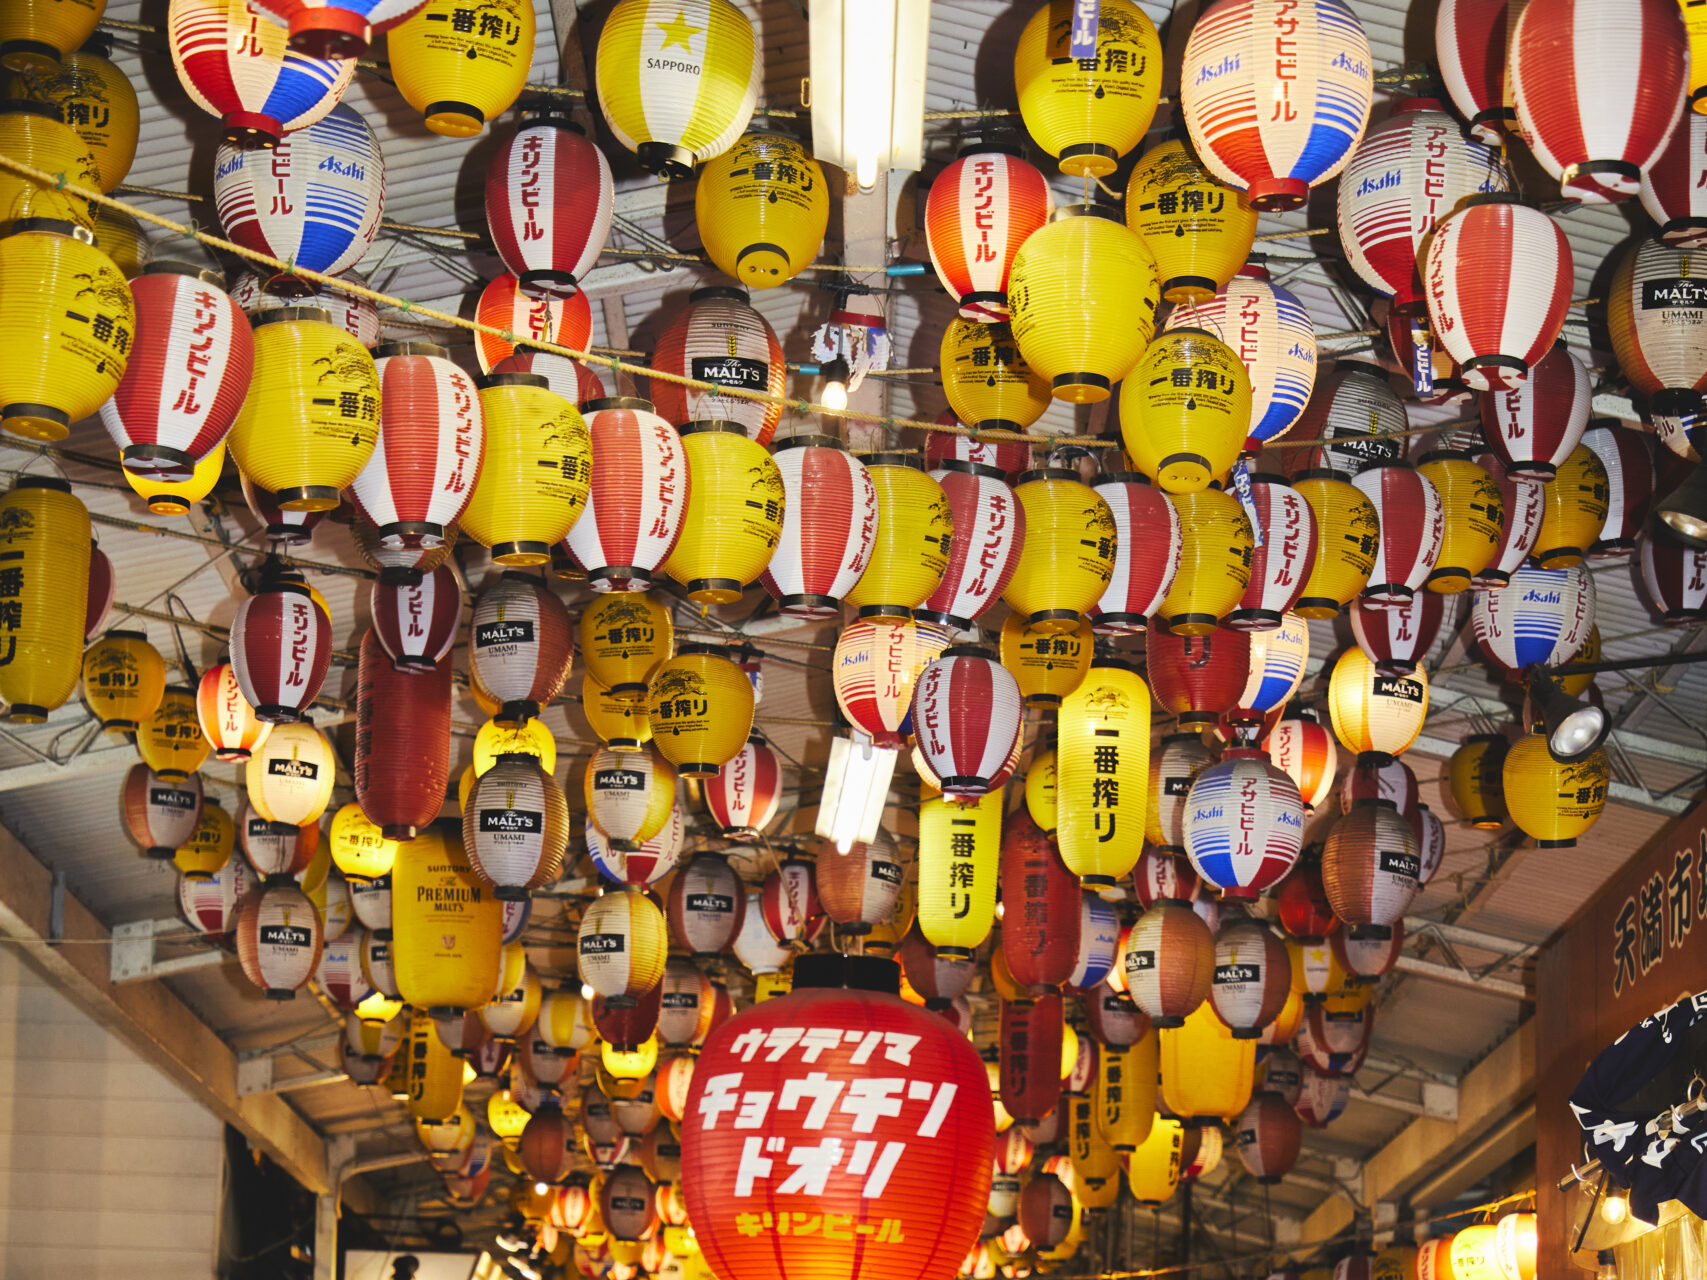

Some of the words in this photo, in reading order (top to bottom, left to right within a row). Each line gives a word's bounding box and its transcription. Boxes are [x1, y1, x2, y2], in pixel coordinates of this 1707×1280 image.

[426, 9, 520, 46] 一番搾り
[647, 58, 701, 75] SAPPORO
[1051, 49, 1146, 76] 一番搾り
[1196, 53, 1241, 87] Asahi
[1270, 0, 1300, 122] アサヒビール
[1331, 51, 1368, 81] Asahi
[64, 102, 109, 128] 搾り
[319, 155, 364, 181] Asahi
[730, 162, 814, 192] 一番搾り
[1417, 126, 1448, 234] アサヒビール
[522, 135, 544, 241] キリンビール
[1357, 169, 1401, 198] Asahi
[974, 161, 997, 263] キリンビール
[1139, 191, 1225, 216] 一番搾り
[1430, 221, 1455, 334] キリンビール
[1661, 311, 1704, 320] UMAMI
[66, 310, 132, 356] 一番搾
[1239, 295, 1260, 394] アサヒビー
[173, 291, 218, 415] キリンビール
[723, 358, 743, 367] The
[1286, 341, 1314, 366] Asahi
[703, 365, 760, 382] MALT'S
[1149, 368, 1235, 396] 一番搾り
[312, 390, 381, 421] 一番搾
[444, 374, 469, 494] キリンビール
[538, 455, 593, 485] 一番搾
[648, 425, 676, 538] キリンビール
[1513, 481, 1541, 552] リンビール
[965, 494, 1006, 597] キリンビール
[1274, 495, 1300, 586] キリンビール
[407, 584, 424, 637] ンビール
[1523, 589, 1561, 604] Asahi
[285, 603, 308, 687] キリンビール
[482, 626, 524, 641] MALT'S
[594, 626, 654, 643] 一番搾り
[1019, 639, 1081, 657] 一番搾り
[1276, 629, 1303, 645] Asahi
[840, 651, 870, 667] Asahi
[88, 672, 138, 687] 一番搾り
[1381, 682, 1419, 697] MALT'S
[650, 699, 708, 720] 一番搾り
[921, 667, 946, 755] キリンビール
[1279, 725, 1293, 770] キリンビ
[274, 762, 313, 777] MALT'S
[600, 773, 639, 787] MALT'S
[1093, 729, 1120, 843] 一番搾り
[487, 815, 534, 829] MALT'S
[1192, 806, 1224, 821] Asahi
[1235, 777, 1258, 856] アサヒビール
[193, 831, 221, 844] 搾り
[492, 833, 525, 842] UMAMI
[427, 864, 471, 873] SUNTORY
[950, 818, 975, 919] 一番搾り
[417, 886, 481, 904] PREMIUM
[434, 902, 464, 912] MALT'S
[1023, 860, 1049, 956] 一番搾り
[267, 930, 306, 942] MALT'S
[583, 938, 617, 950] MALT'S
[1217, 969, 1252, 981] MALT'S
[730, 1027, 922, 1067] ウラテンマ
[698, 1072, 958, 1138] チョウチン
[1106, 1055, 1122, 1125] 一番搾り
[734, 1136, 906, 1199] ドオリ
[1168, 1133, 1181, 1187] 番搾り
[735, 1212, 905, 1244] キリンビール
